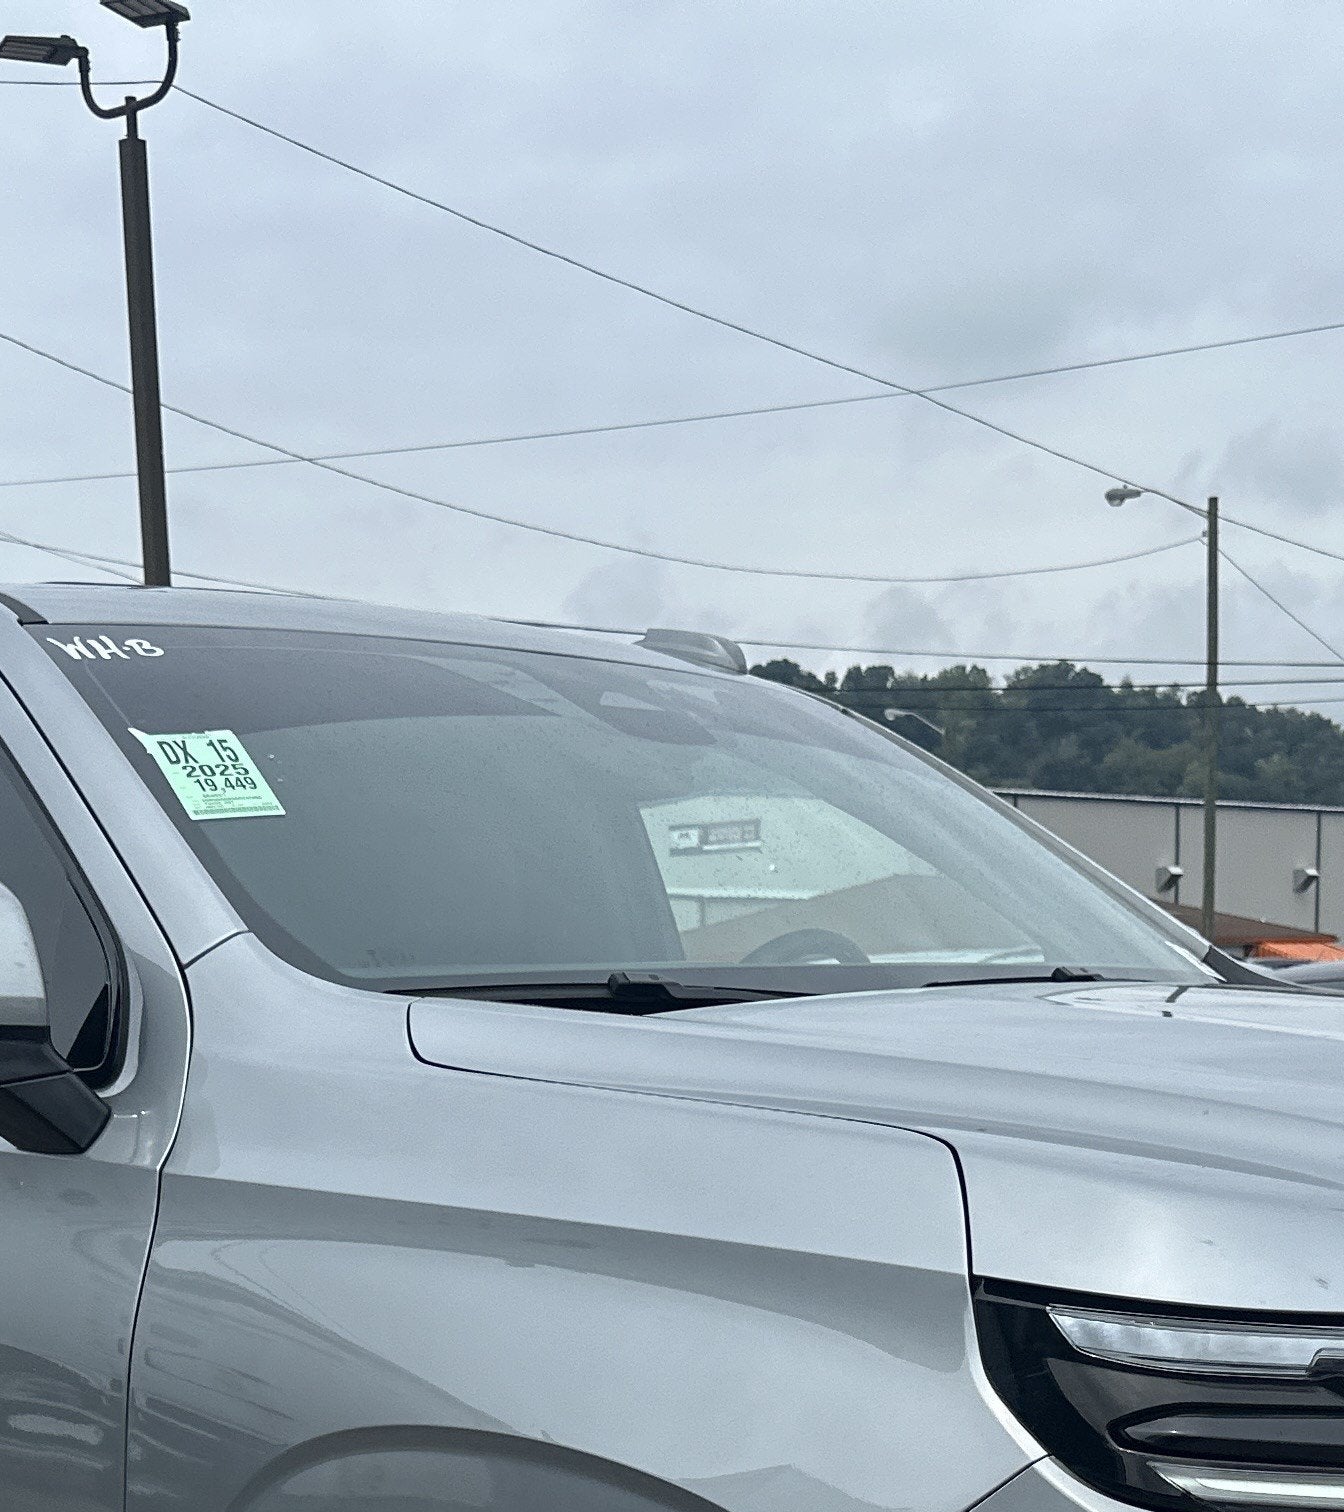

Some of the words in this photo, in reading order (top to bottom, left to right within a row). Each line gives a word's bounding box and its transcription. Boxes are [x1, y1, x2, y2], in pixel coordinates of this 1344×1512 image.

[156, 739, 199, 765] DX
[206, 738, 240, 763] 15
[181, 762, 250, 778] 2025
[193, 776, 258, 795] 19,449
